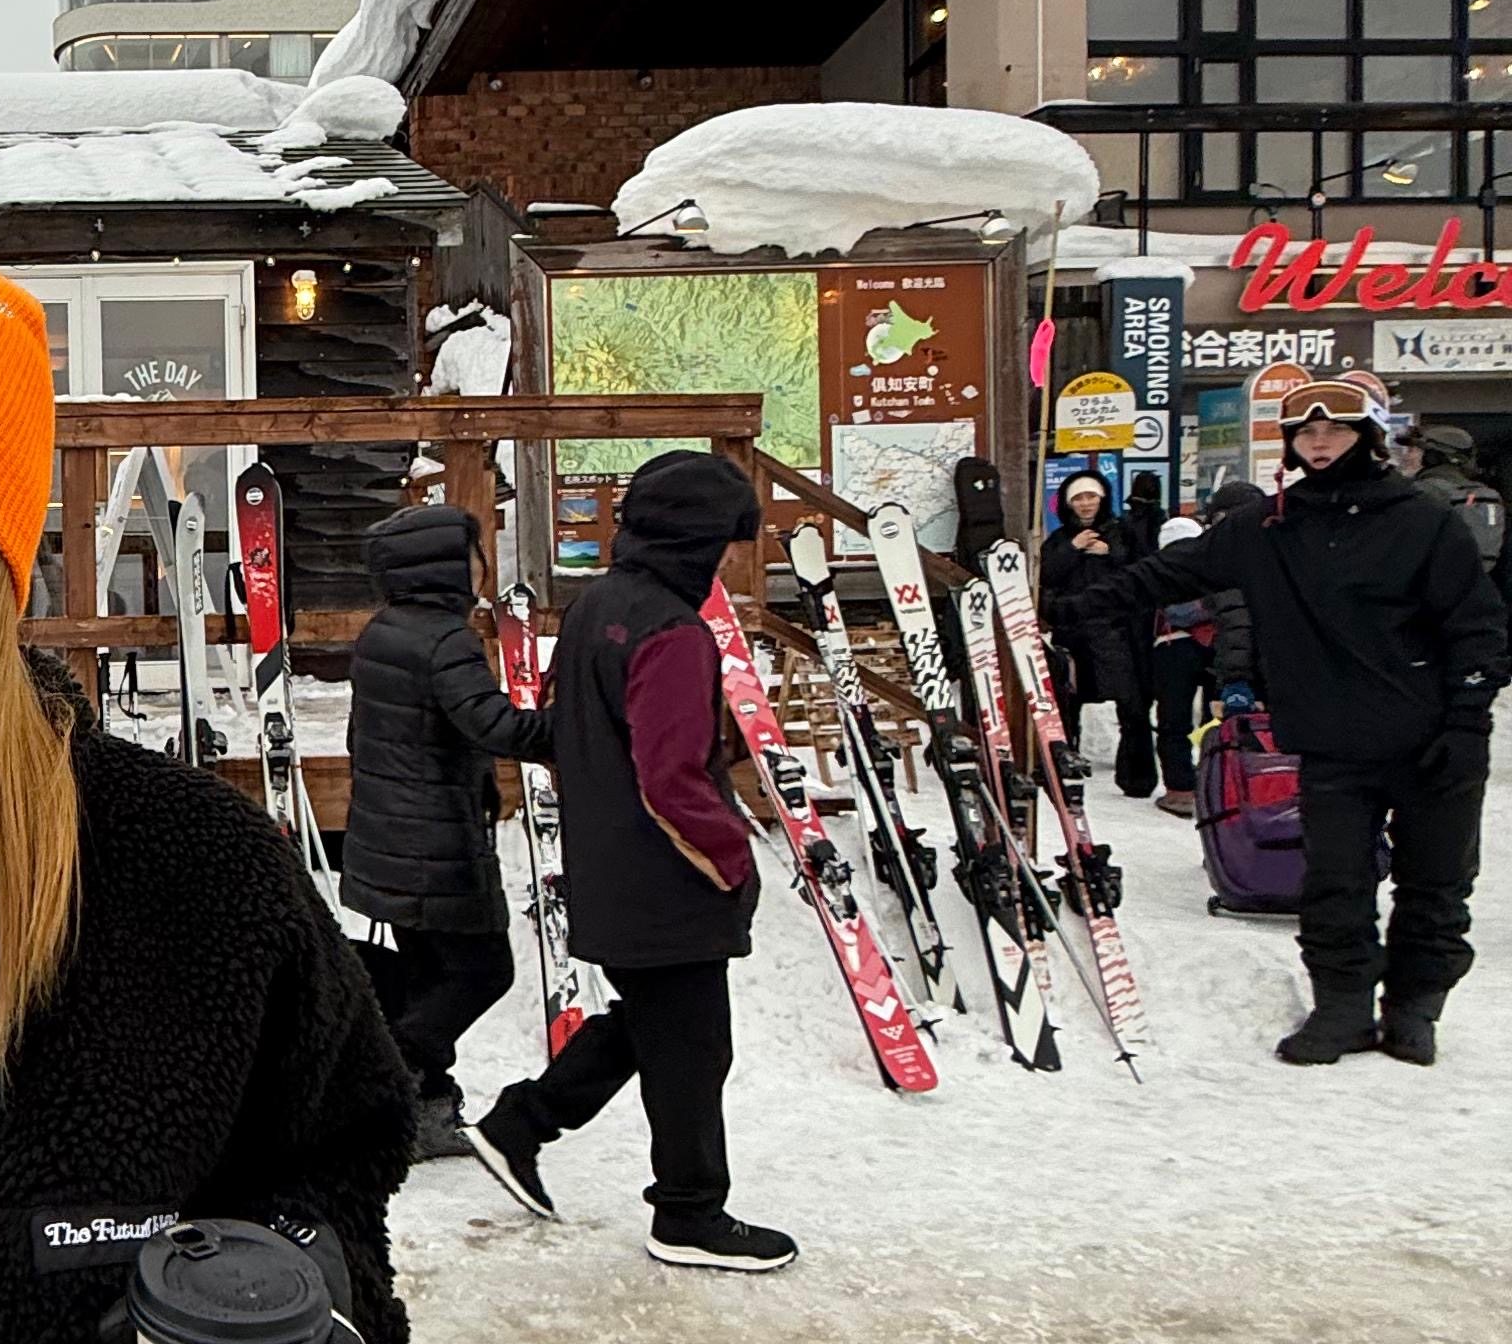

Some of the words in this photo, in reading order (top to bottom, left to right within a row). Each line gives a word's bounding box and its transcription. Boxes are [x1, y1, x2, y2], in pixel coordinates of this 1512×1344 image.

[1228, 217, 1512, 313] Welc
[1124, 297, 1146, 359] AREA
[1146, 297, 1170, 405] SMOKING
[123, 360, 161, 392] THE
[164, 360, 203, 392] DAY
[43, 1222, 92, 1247] The
